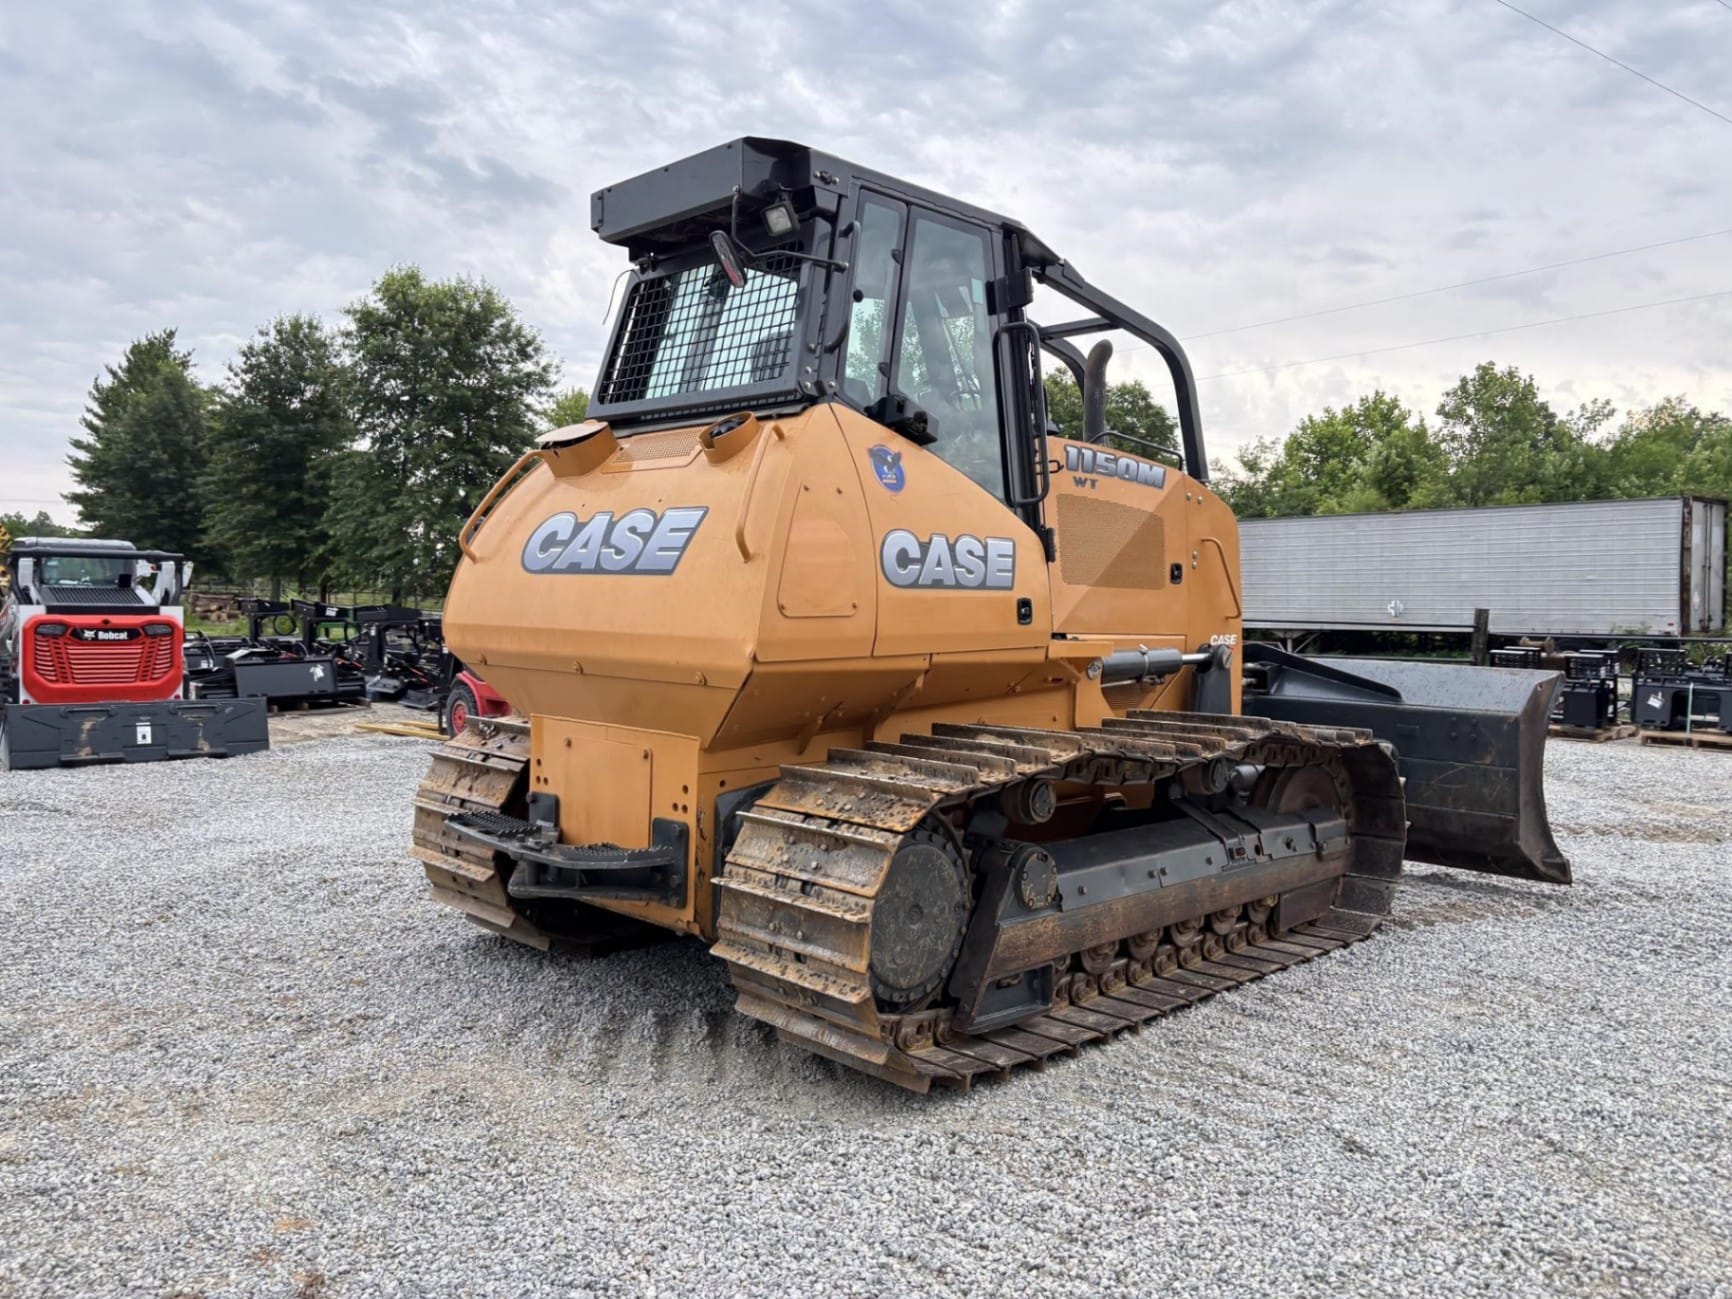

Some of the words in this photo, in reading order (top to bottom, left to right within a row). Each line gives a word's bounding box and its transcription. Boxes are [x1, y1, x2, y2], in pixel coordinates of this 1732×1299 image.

[1064, 445, 1166, 489] 1150M
[1073, 476, 1098, 489] WT
[521, 506, 709, 574] CASE
[880, 528, 1015, 590] CASE
[98, 630, 128, 641] Bobcat
[1210, 634, 1237, 645] CASE
